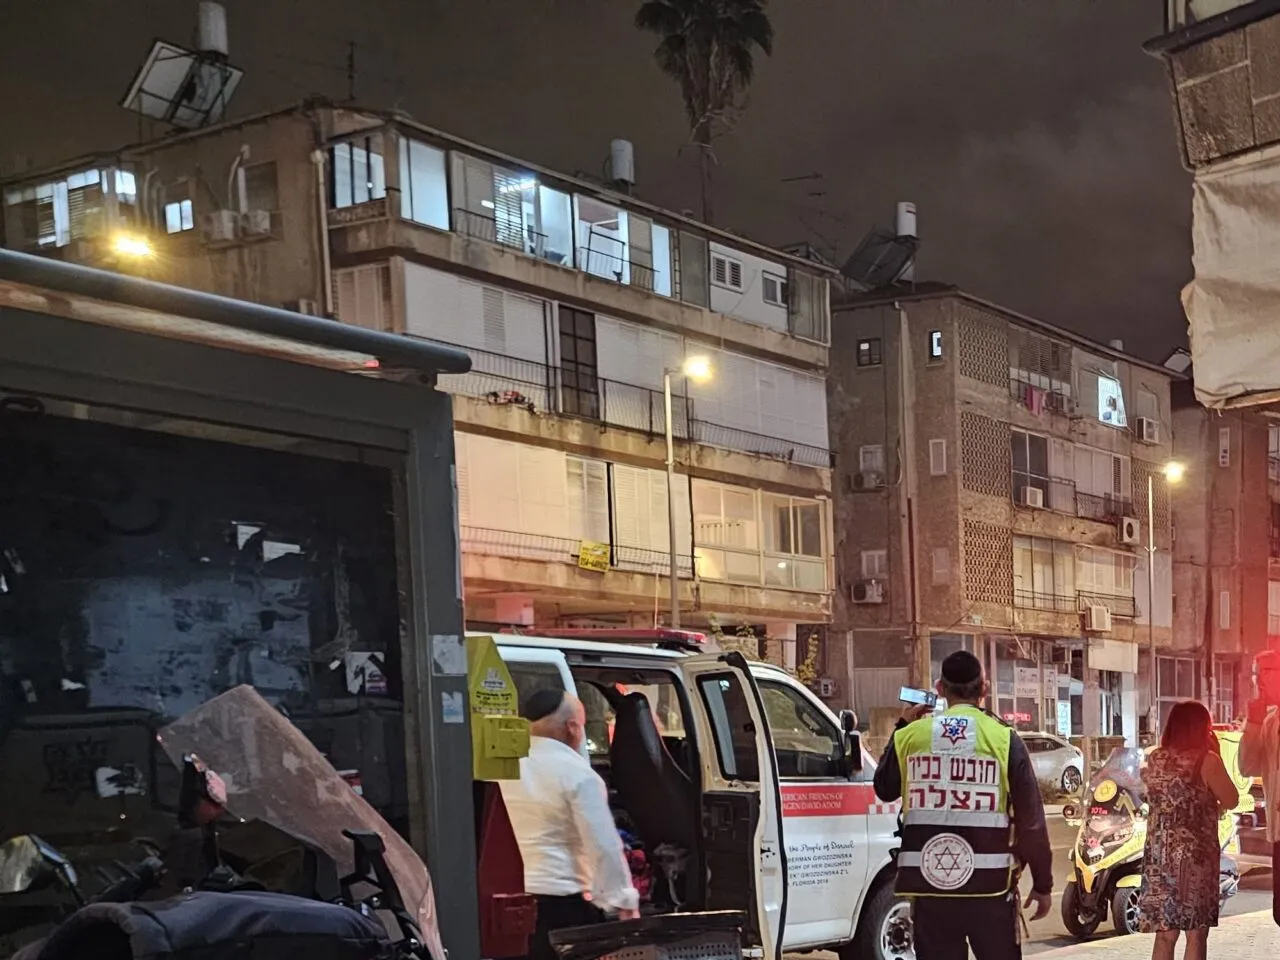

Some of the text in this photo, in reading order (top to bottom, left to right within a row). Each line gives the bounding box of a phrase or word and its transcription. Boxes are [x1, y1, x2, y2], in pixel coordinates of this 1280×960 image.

[908, 756, 997, 785] חובש בכיר
[908, 784, 996, 812] הצלה
